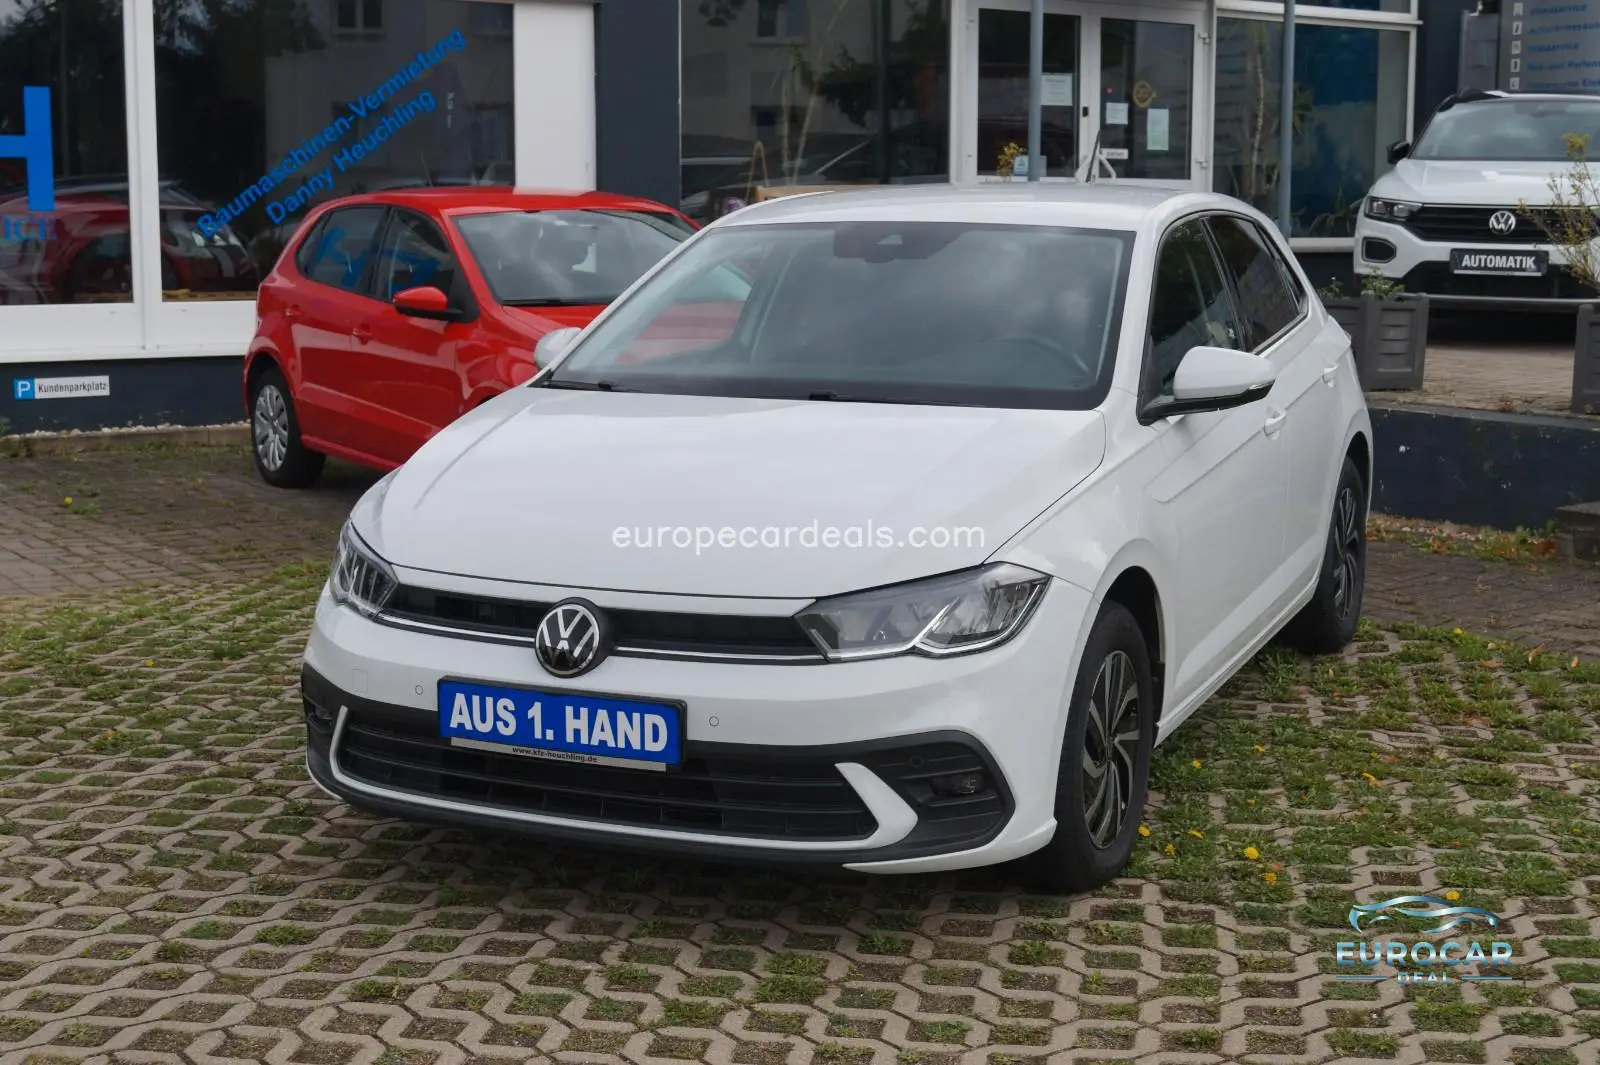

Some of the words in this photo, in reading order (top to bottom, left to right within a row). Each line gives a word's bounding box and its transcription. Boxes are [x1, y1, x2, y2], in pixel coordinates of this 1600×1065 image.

[196, 27, 466, 238] Baumaschinen-Vermietung
[264, 165, 335, 225] Danny
[332, 90, 437, 172] Heuchling
[1461, 254, 1536, 269] AUTOMATIK
[38, 381, 107, 394] Kundenparkplatz
[450, 692, 517, 736] AUS
[527, 701, 554, 741] 1.
[565, 705, 668, 752] HAND
